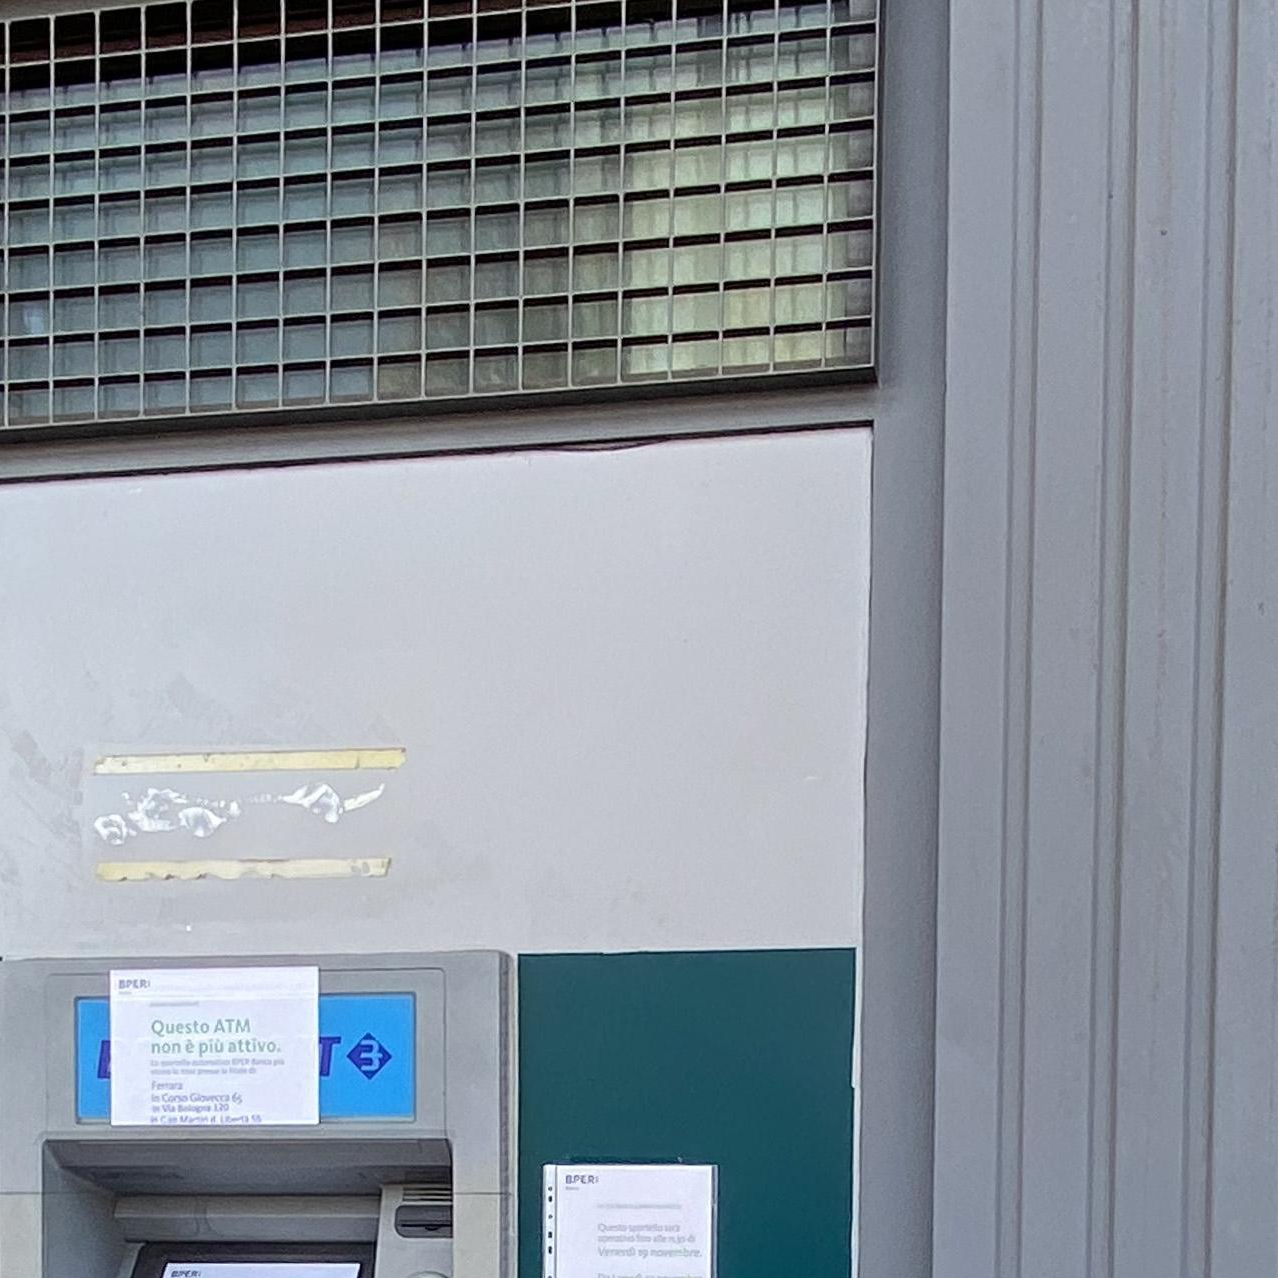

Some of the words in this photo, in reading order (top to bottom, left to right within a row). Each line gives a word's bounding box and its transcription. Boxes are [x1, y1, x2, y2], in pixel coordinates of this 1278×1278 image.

[151, 1019, 210, 1037] Questo
[214, 1018, 251, 1033] ATM
[151, 1042, 181, 1054] non
[185, 1039, 195, 1053] è
[199, 1038, 224, 1058] più
[228, 1038, 282, 1053] attivo.
[151, 1080, 183, 1091] Ferrara
[161, 1092, 188, 1103] Corso
[190, 1092, 230, 1103] Giovecca
[161, 1103, 176, 1113] Via
[177, 1104, 211, 1114] Bologna
[597, 1223, 627, 1233] Questo
[597, 1246, 636, 1257] Venerdì
[650, 1247, 703, 1258] novembre.
